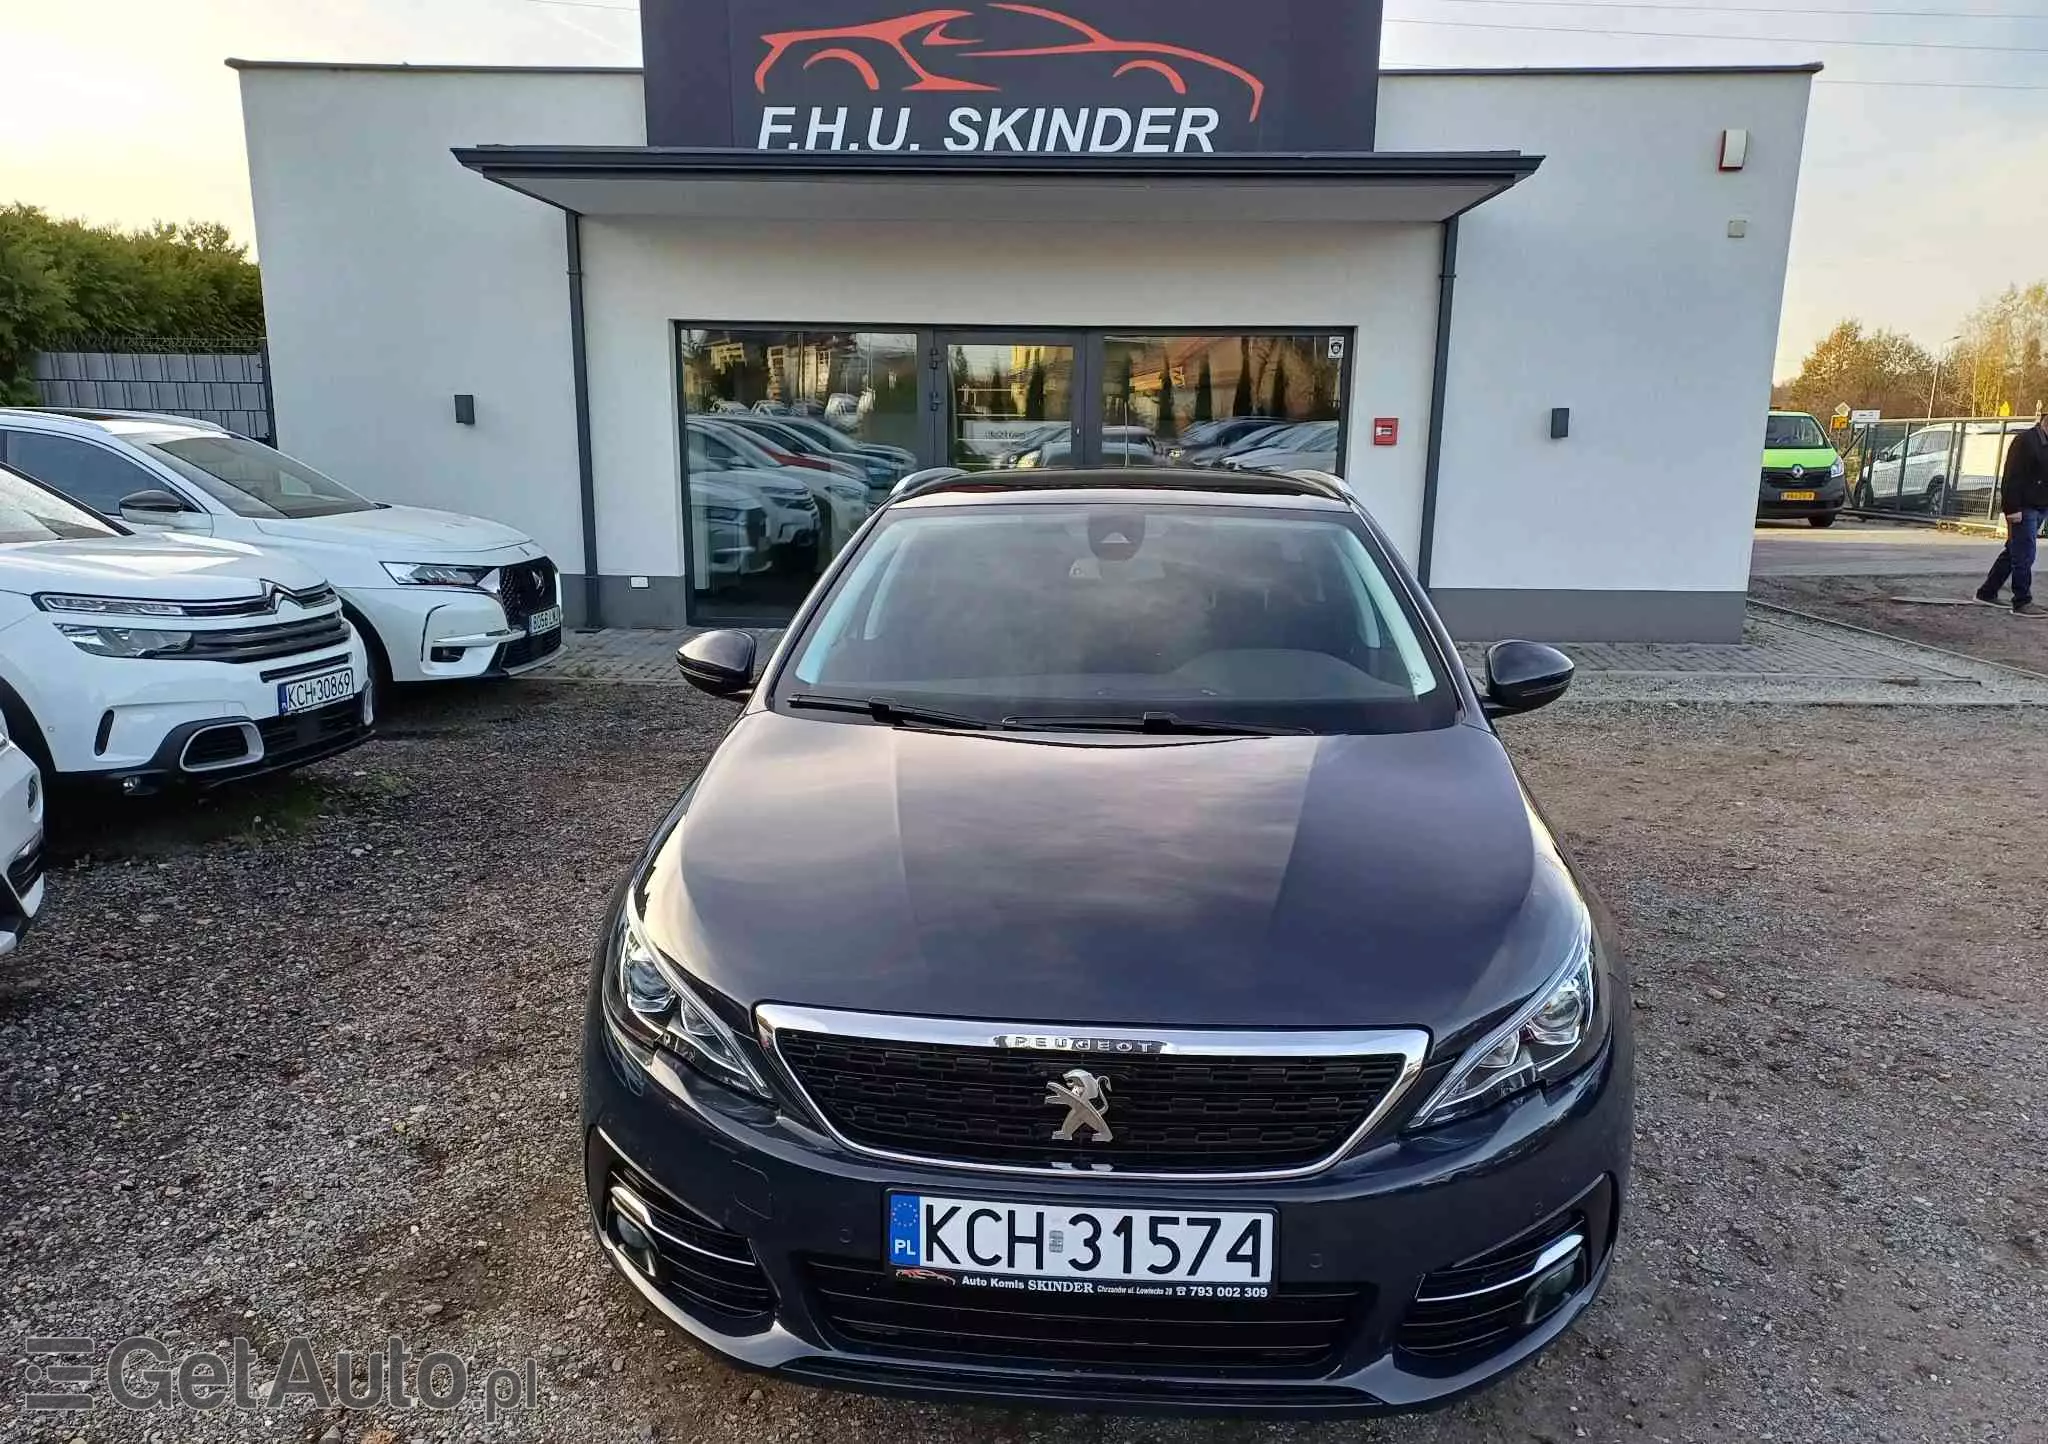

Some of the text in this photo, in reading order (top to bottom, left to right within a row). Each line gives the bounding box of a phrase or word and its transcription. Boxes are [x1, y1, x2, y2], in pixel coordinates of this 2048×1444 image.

[758, 106, 1220, 153] F.H.U. SKINDER
[287, 673, 350, 708] KCH 30869
[1014, 1036, 1152, 1053] PEUGEOT
[895, 1239, 916, 1256] PL
[924, 1203, 1262, 1278] KCH 31574
[961, 1275, 987, 1287] Auto
[990, 1278, 1025, 1290] Komis
[1027, 1279, 1095, 1294] SKINDER
[1189, 1286, 1213, 1297] 793
[1216, 1287, 1241, 1297] 002
[1244, 1287, 1268, 1298] 309
